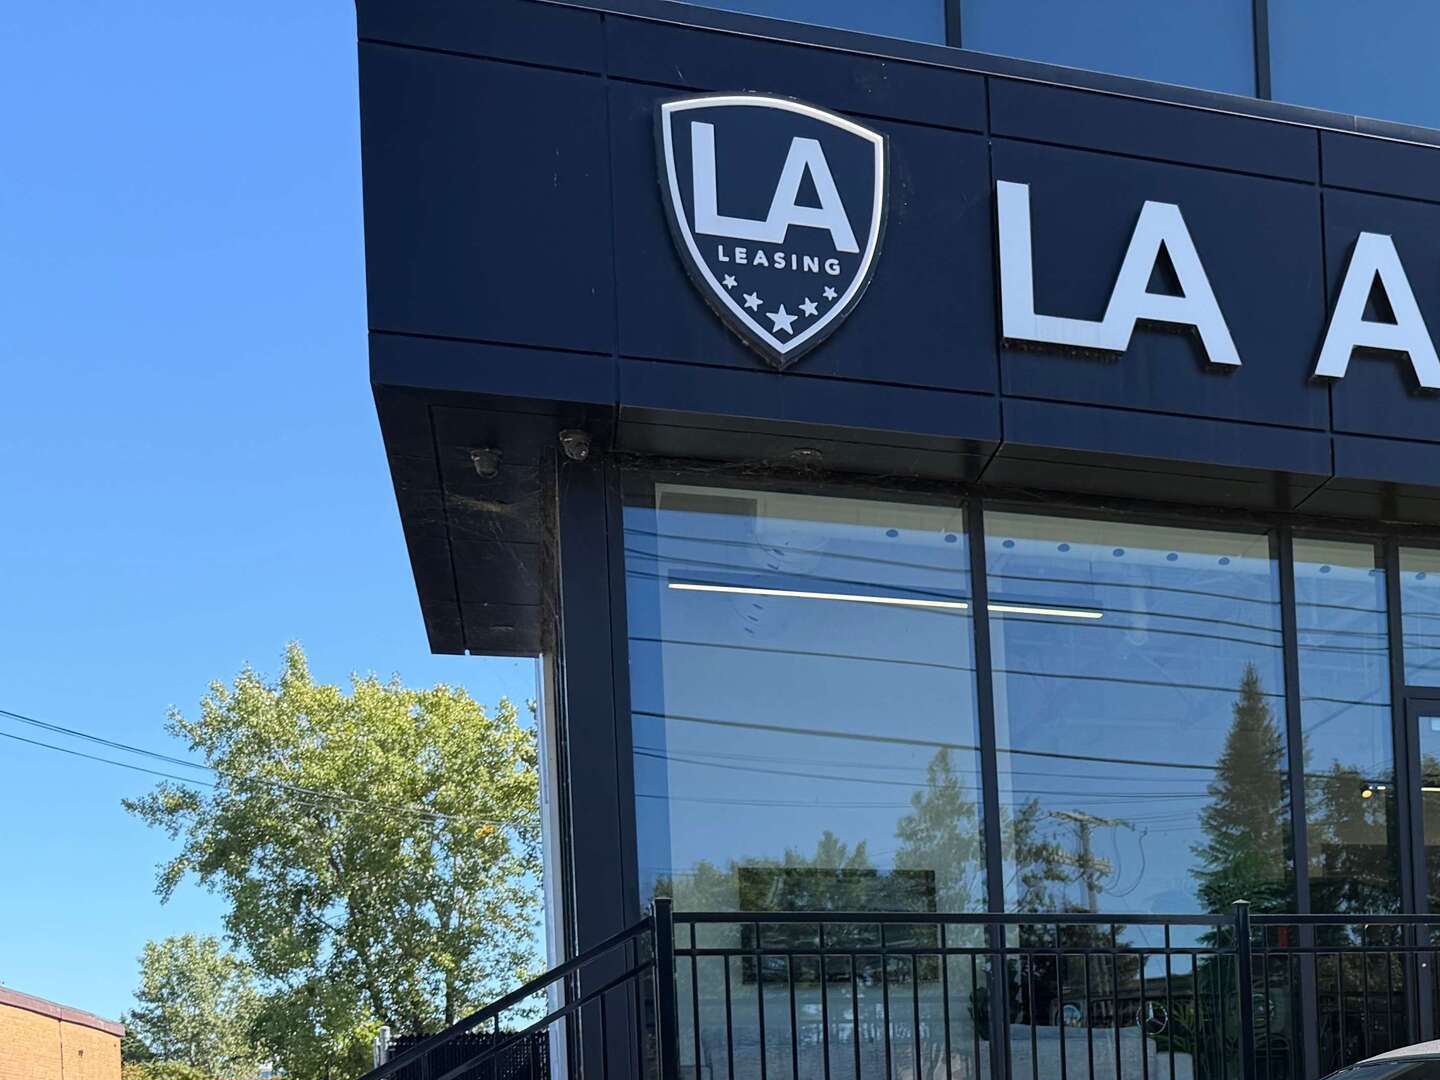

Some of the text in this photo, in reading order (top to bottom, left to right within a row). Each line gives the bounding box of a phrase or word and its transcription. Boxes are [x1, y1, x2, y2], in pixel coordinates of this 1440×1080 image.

[691, 121, 860, 253] LA
[718, 245, 841, 275] LEASING
[999, 180, 1241, 367] LA
